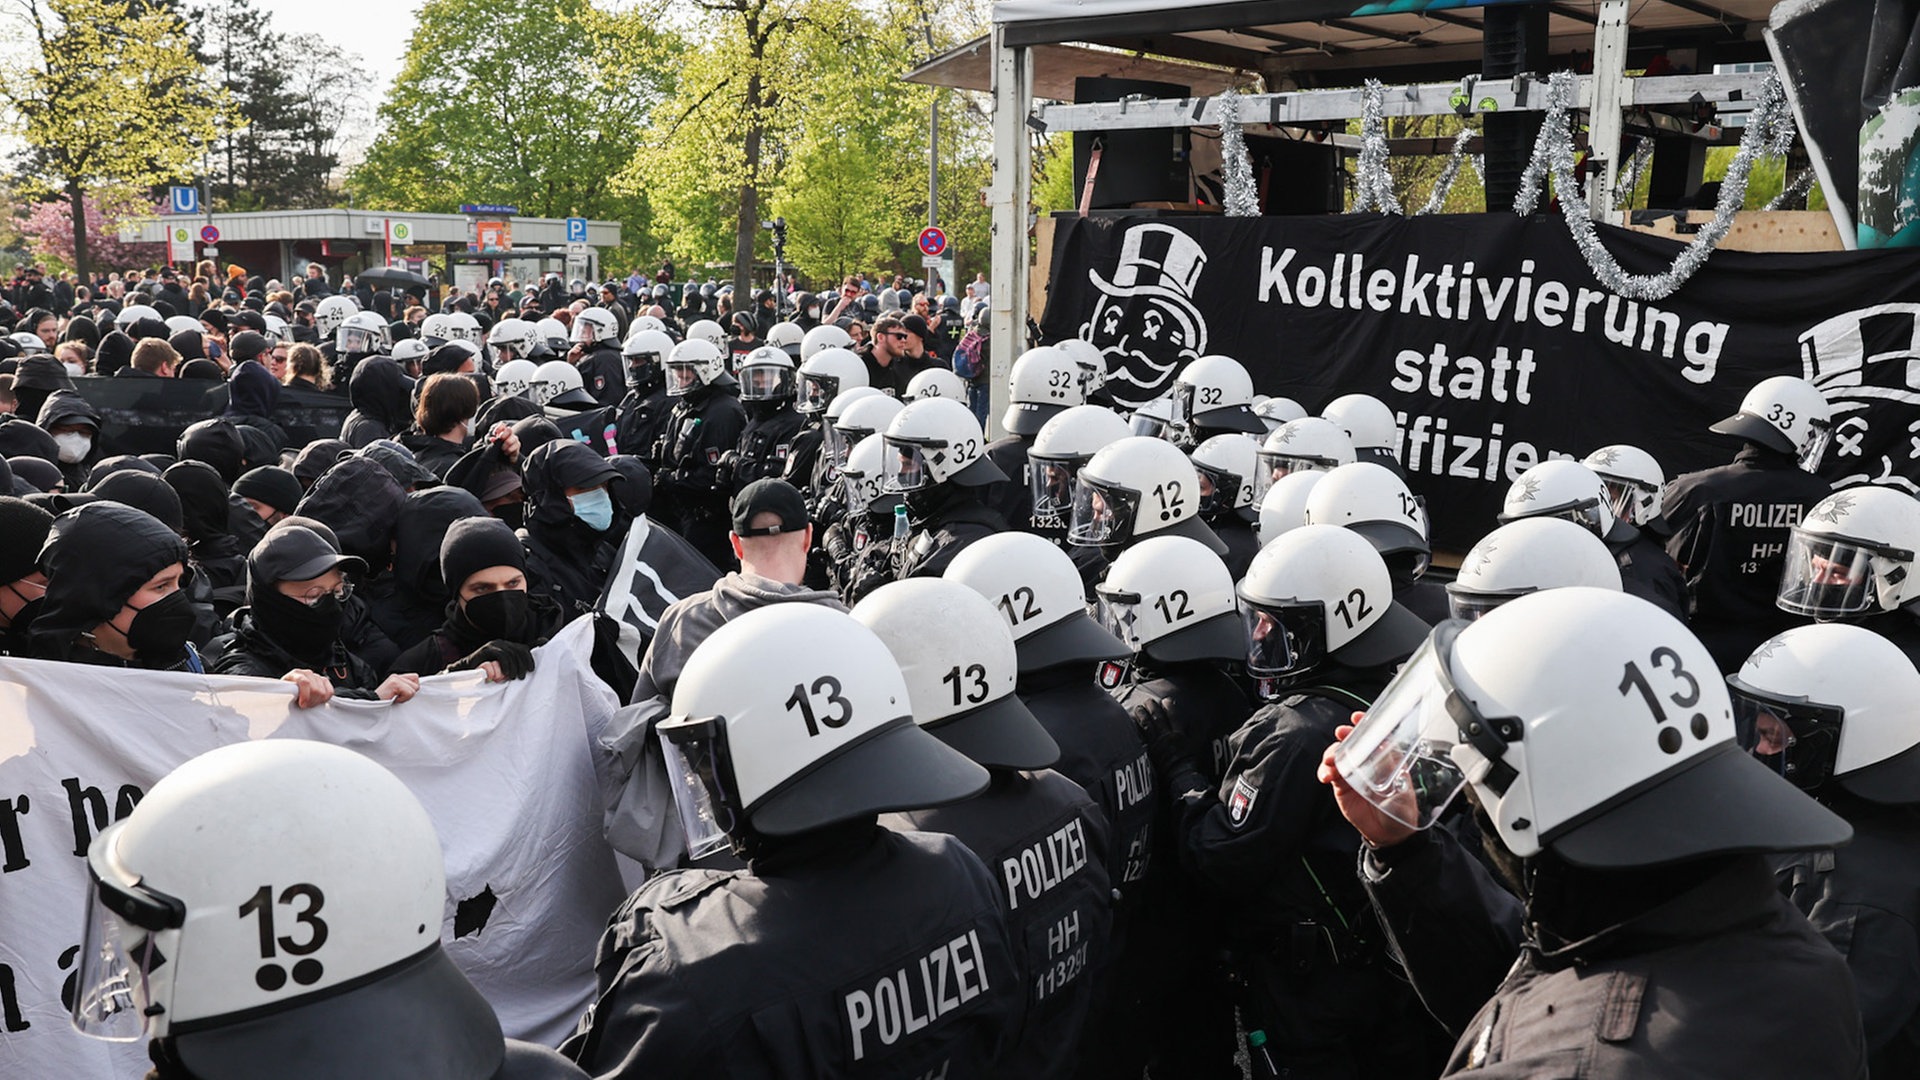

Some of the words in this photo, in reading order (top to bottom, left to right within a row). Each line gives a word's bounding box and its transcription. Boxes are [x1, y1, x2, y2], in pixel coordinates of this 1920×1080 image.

[175, 188, 195, 211] U
[571, 221, 583, 239] P
[331, 307, 343, 316] 24
[1258, 246, 1730, 384] Kollektivierung
[711, 356, 722, 372] 32
[1390, 343, 1537, 405] statt
[510, 380, 526, 393] 34
[551, 381, 568, 395] 32
[921, 384, 941, 398] 32
[1049, 370, 1071, 389] 32
[1200, 388, 1222, 404] 32
[1767, 403, 1796, 430] 33
[953, 439, 977, 464] 32
[1152, 480, 1185, 510] 12
[1397, 492, 1418, 521] 12
[1730, 503, 1803, 528] POLIZEI
[1740, 561, 1760, 574] 13
[997, 586, 1043, 627] 12
[1154, 589, 1195, 624] 12
[1334, 588, 1374, 630] 12
[942, 663, 990, 706] 13
[1618, 645, 1701, 725] 13
[785, 675, 854, 738] 13
[1003, 817, 1088, 910] POLIZEI
[239, 882, 329, 959] 13
[1048, 910, 1080, 960] HH
[845, 929, 990, 1062] POLIZEI
